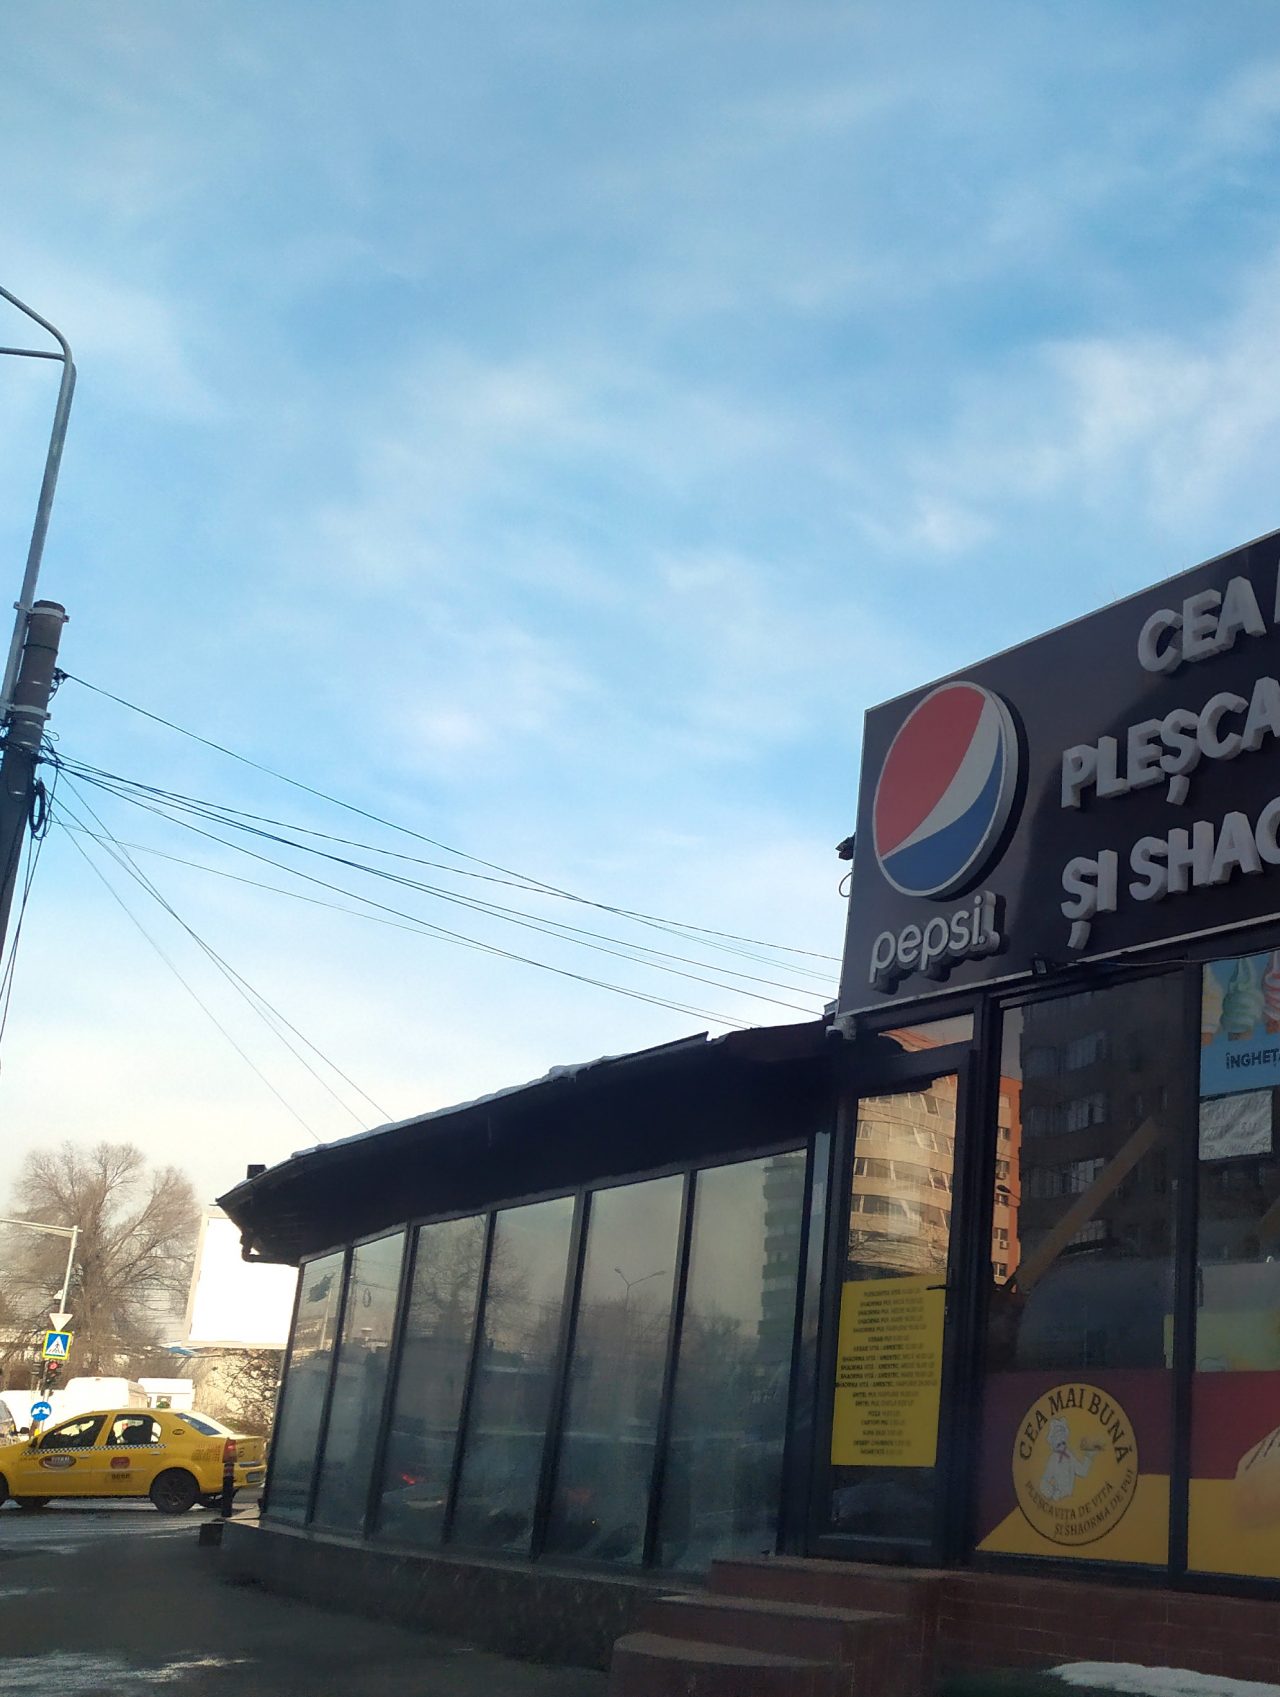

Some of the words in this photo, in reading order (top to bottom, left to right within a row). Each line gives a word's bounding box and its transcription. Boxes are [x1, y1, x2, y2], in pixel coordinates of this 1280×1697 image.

[1137, 576, 1267, 675] CEA
[1061, 849, 1118, 950] ȘI
[1019, 1409, 1048, 1460] CEA
[1048, 1387, 1086, 1416] MAI
[1087, 1391, 1133, 1464] BUNĂ
